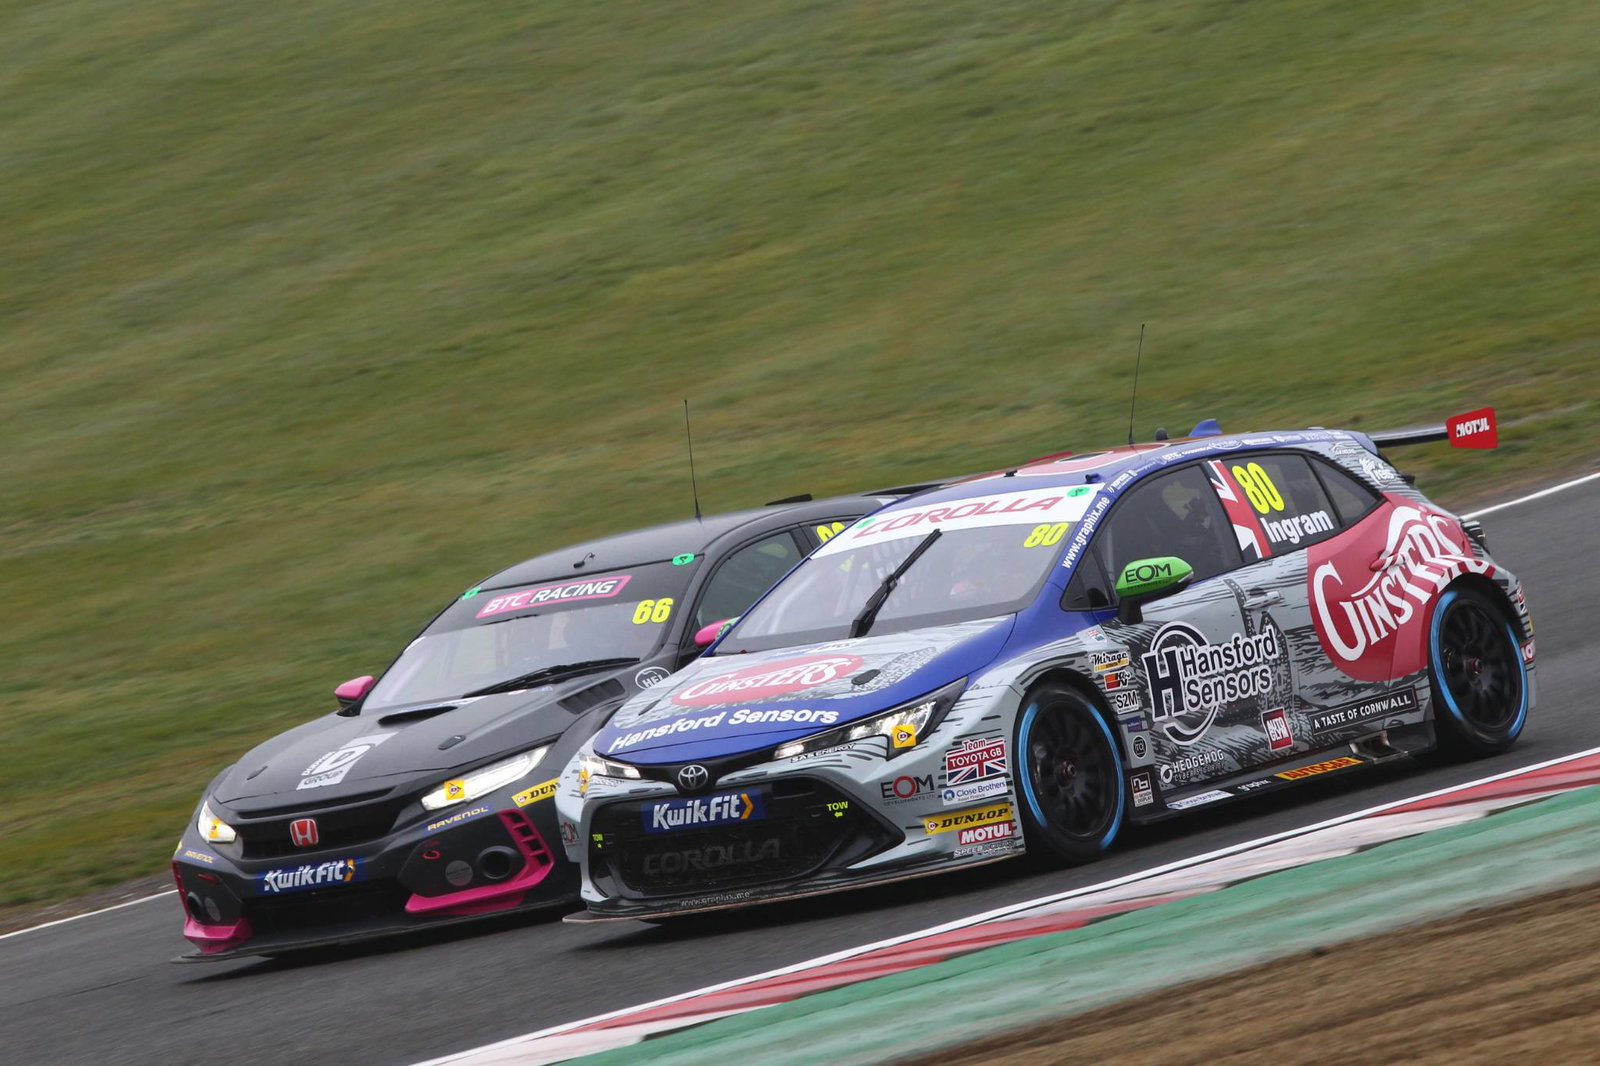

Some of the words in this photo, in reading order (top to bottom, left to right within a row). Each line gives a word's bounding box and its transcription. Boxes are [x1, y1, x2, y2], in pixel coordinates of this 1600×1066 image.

[1456, 417, 1490, 437] MOTUL
[1232, 462, 1285, 514] 80
[852, 496, 1064, 539] COROLLA
[1260, 510, 1334, 544] Ingram
[1023, 522, 1070, 548] 80
[1062, 496, 1110, 569] www.graphix.me
[1125, 563, 1172, 583] EOM
[484, 592, 531, 613] BTC
[530, 580, 618, 603] RACING
[632, 597, 674, 625] 66
[1091, 652, 1128, 665] Mirage
[1178, 625, 1279, 679] Hansford
[1116, 690, 1138, 708] S2M
[1184, 665, 1273, 711] Sensors
[1267, 716, 1285, 731] AUTO
[1314, 719, 1321, 730] A
[1321, 711, 1346, 727] TASTE
[1347, 709, 1358, 721] OF
[1359, 695, 1411, 716] CORNWALL
[608, 711, 727, 752] Hansford
[729, 709, 839, 724] Sensors
[950, 753, 989, 768] TOYOTA
[990, 748, 1003, 759] GB
[964, 740, 986, 752] Team
[1172, 749, 1225, 773] HEDGEHOG
[1284, 758, 1354, 780] AUTOCAR
[881, 774, 935, 798] EOM
[957, 788, 977, 799] Close
[978, 780, 1006, 793] Brothers
[826, 801, 849, 812] TOW
[941, 808, 1009, 828] DUNLOP
[427, 806, 489, 832] RAVENOL
[961, 823, 1013, 845] MOTUL
[643, 838, 780, 876] COROLLA
